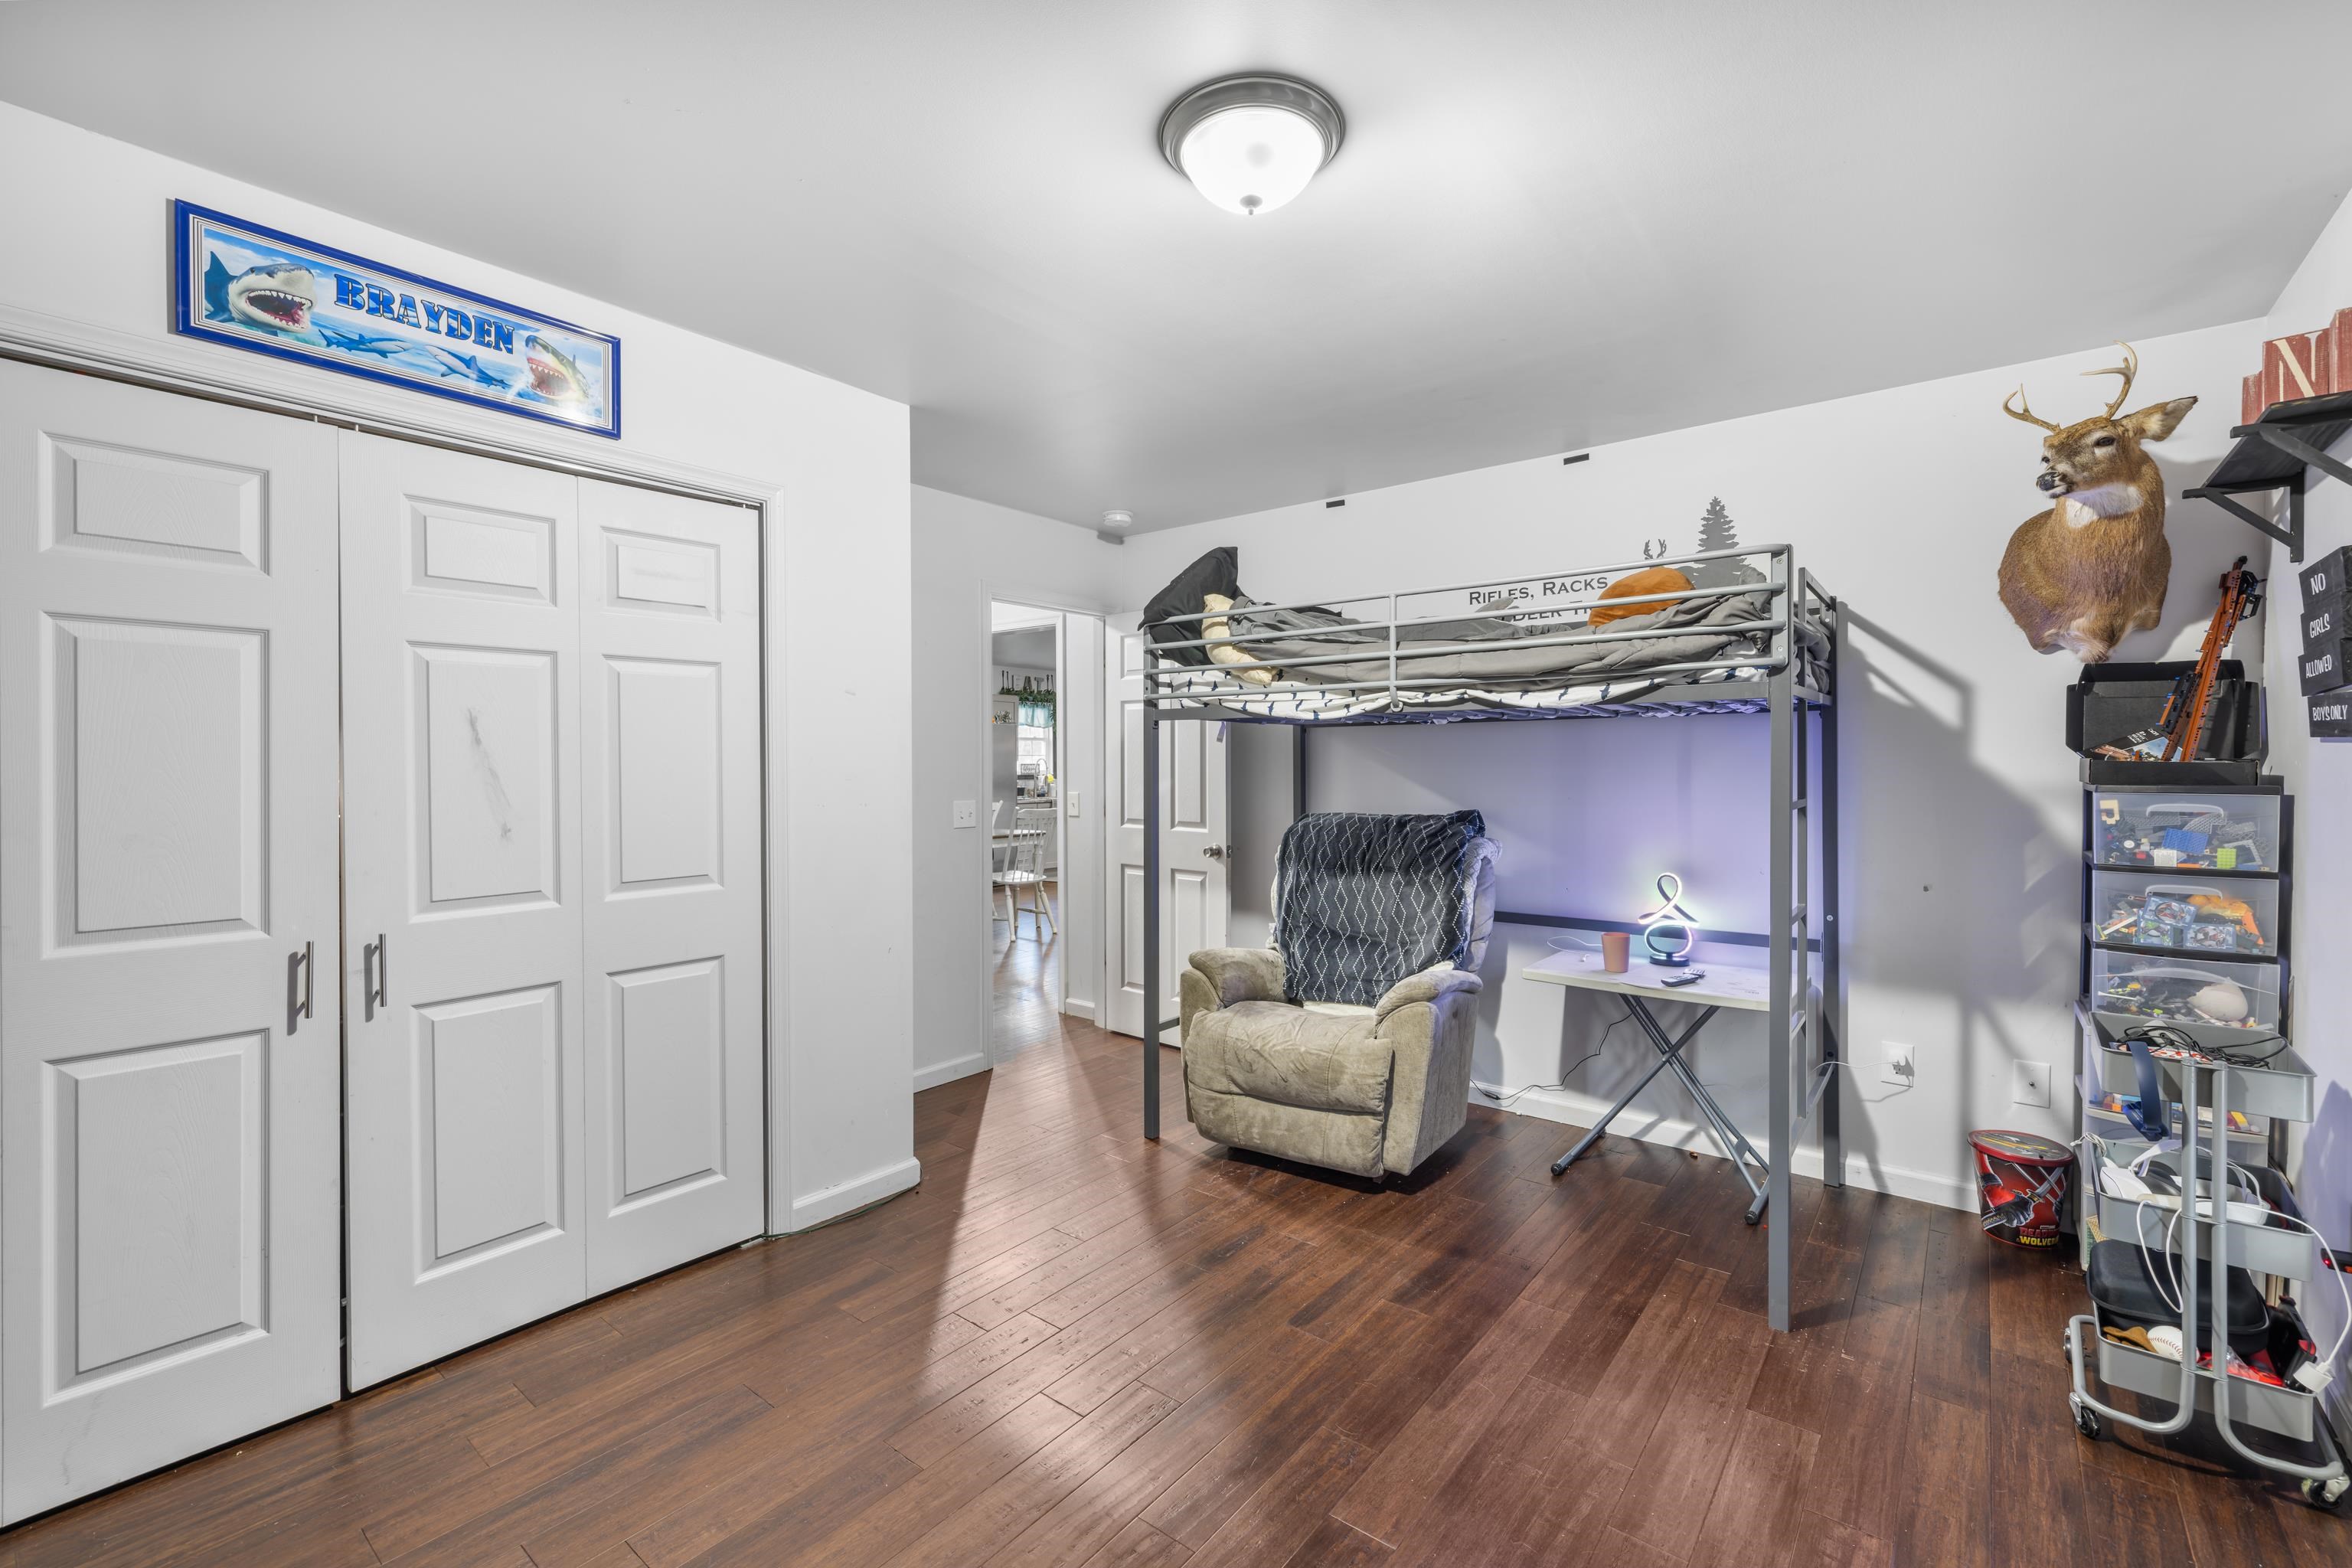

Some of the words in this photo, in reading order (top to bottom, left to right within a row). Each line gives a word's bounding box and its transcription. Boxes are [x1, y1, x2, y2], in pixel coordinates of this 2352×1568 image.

[335, 274, 515, 354] BRAYDEN
[2272, 331, 2323, 402] N
[1543, 577, 1609, 596] RACKS
[2310, 573, 2326, 596] NO
[2309, 613, 2331, 639] GIRLS
[2305, 655, 2332, 678] ALLOWED
[2312, 707, 2330, 721] BOYS
[2330, 705, 2348, 720] ONLY
